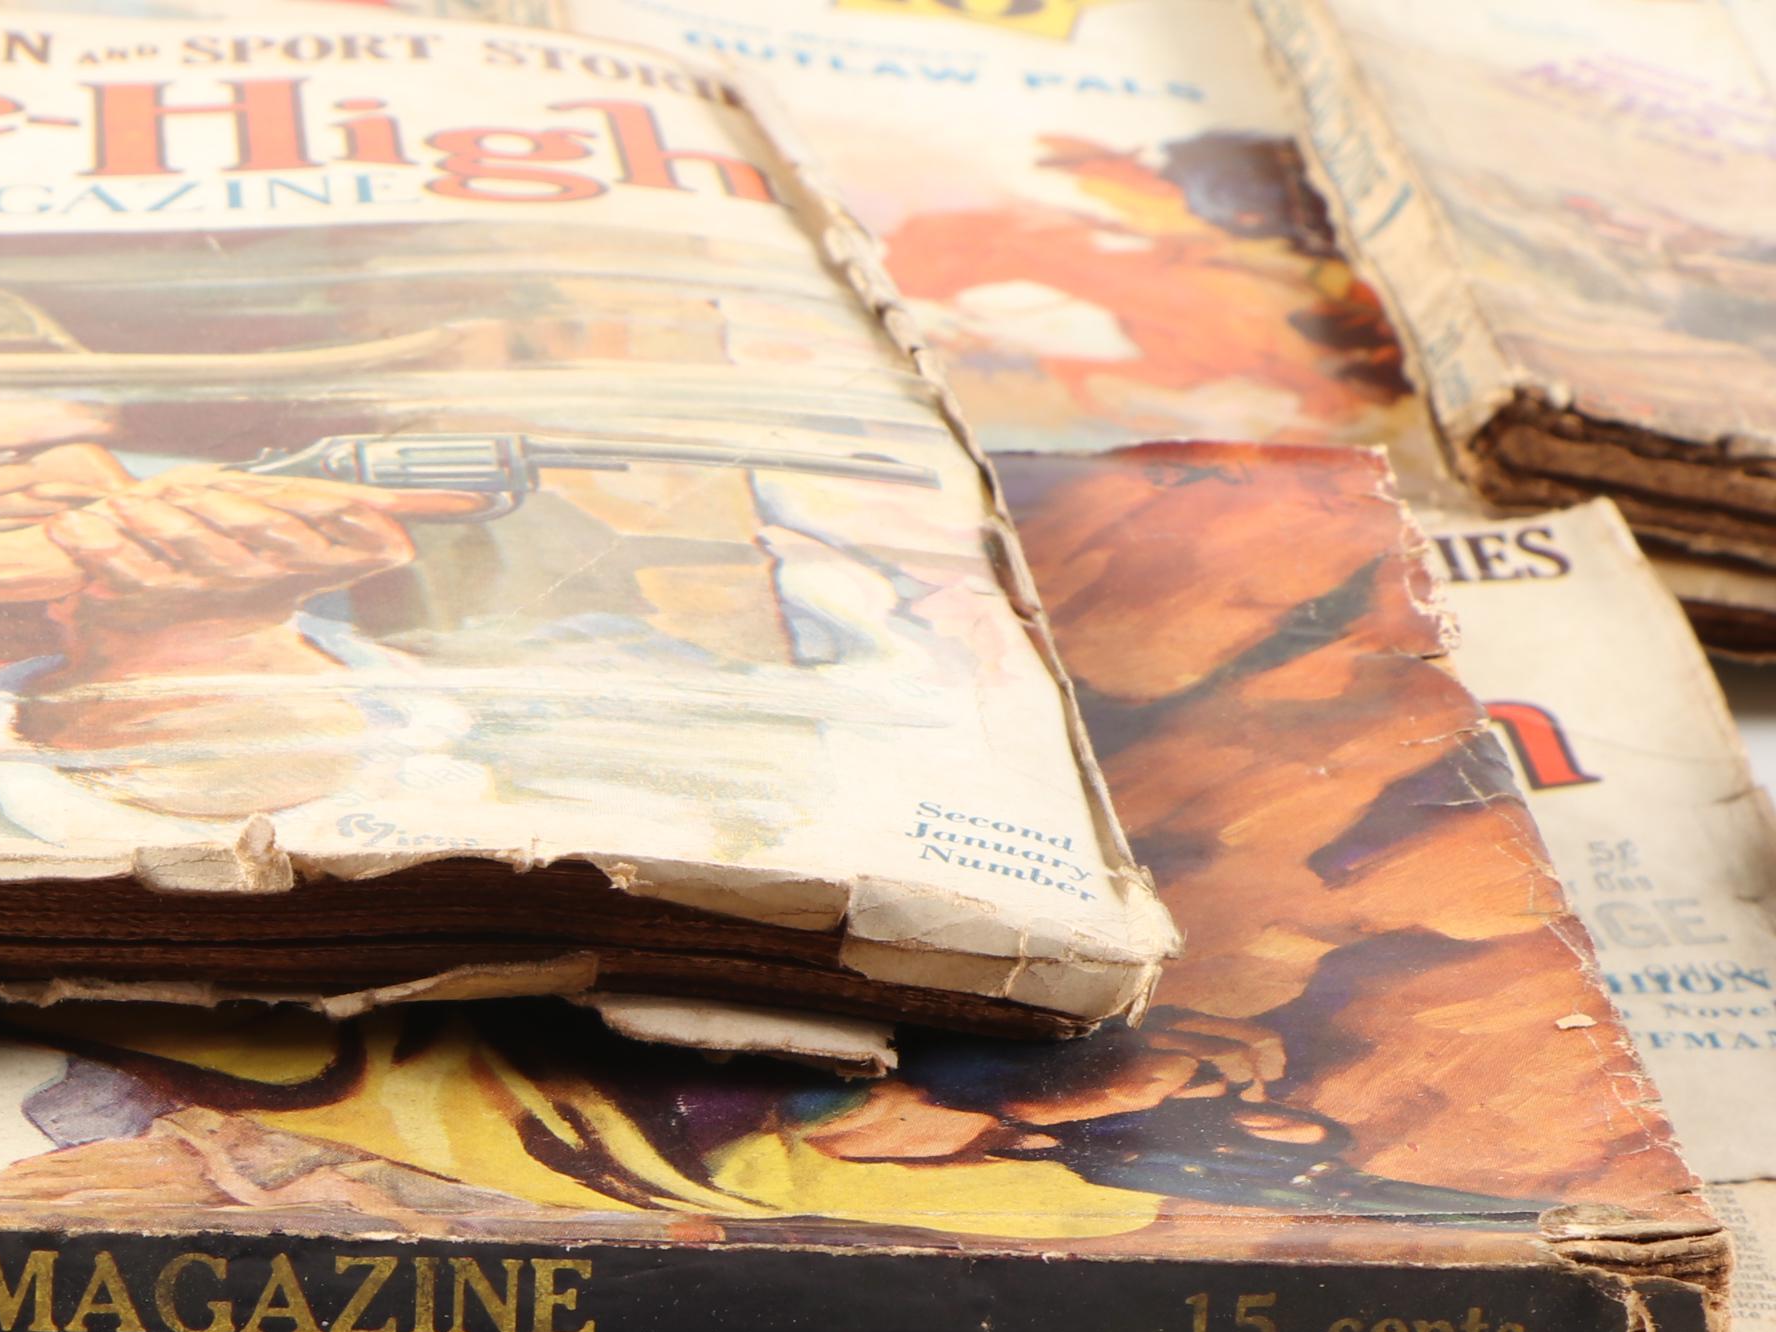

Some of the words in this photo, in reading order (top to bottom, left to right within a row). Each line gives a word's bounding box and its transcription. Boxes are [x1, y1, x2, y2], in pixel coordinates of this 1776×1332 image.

[181, 32, 442, 66] SPORT
[905, 819, 1095, 881] January
[915, 799, 1077, 853] Second
[918, 841, 1100, 903] Number
